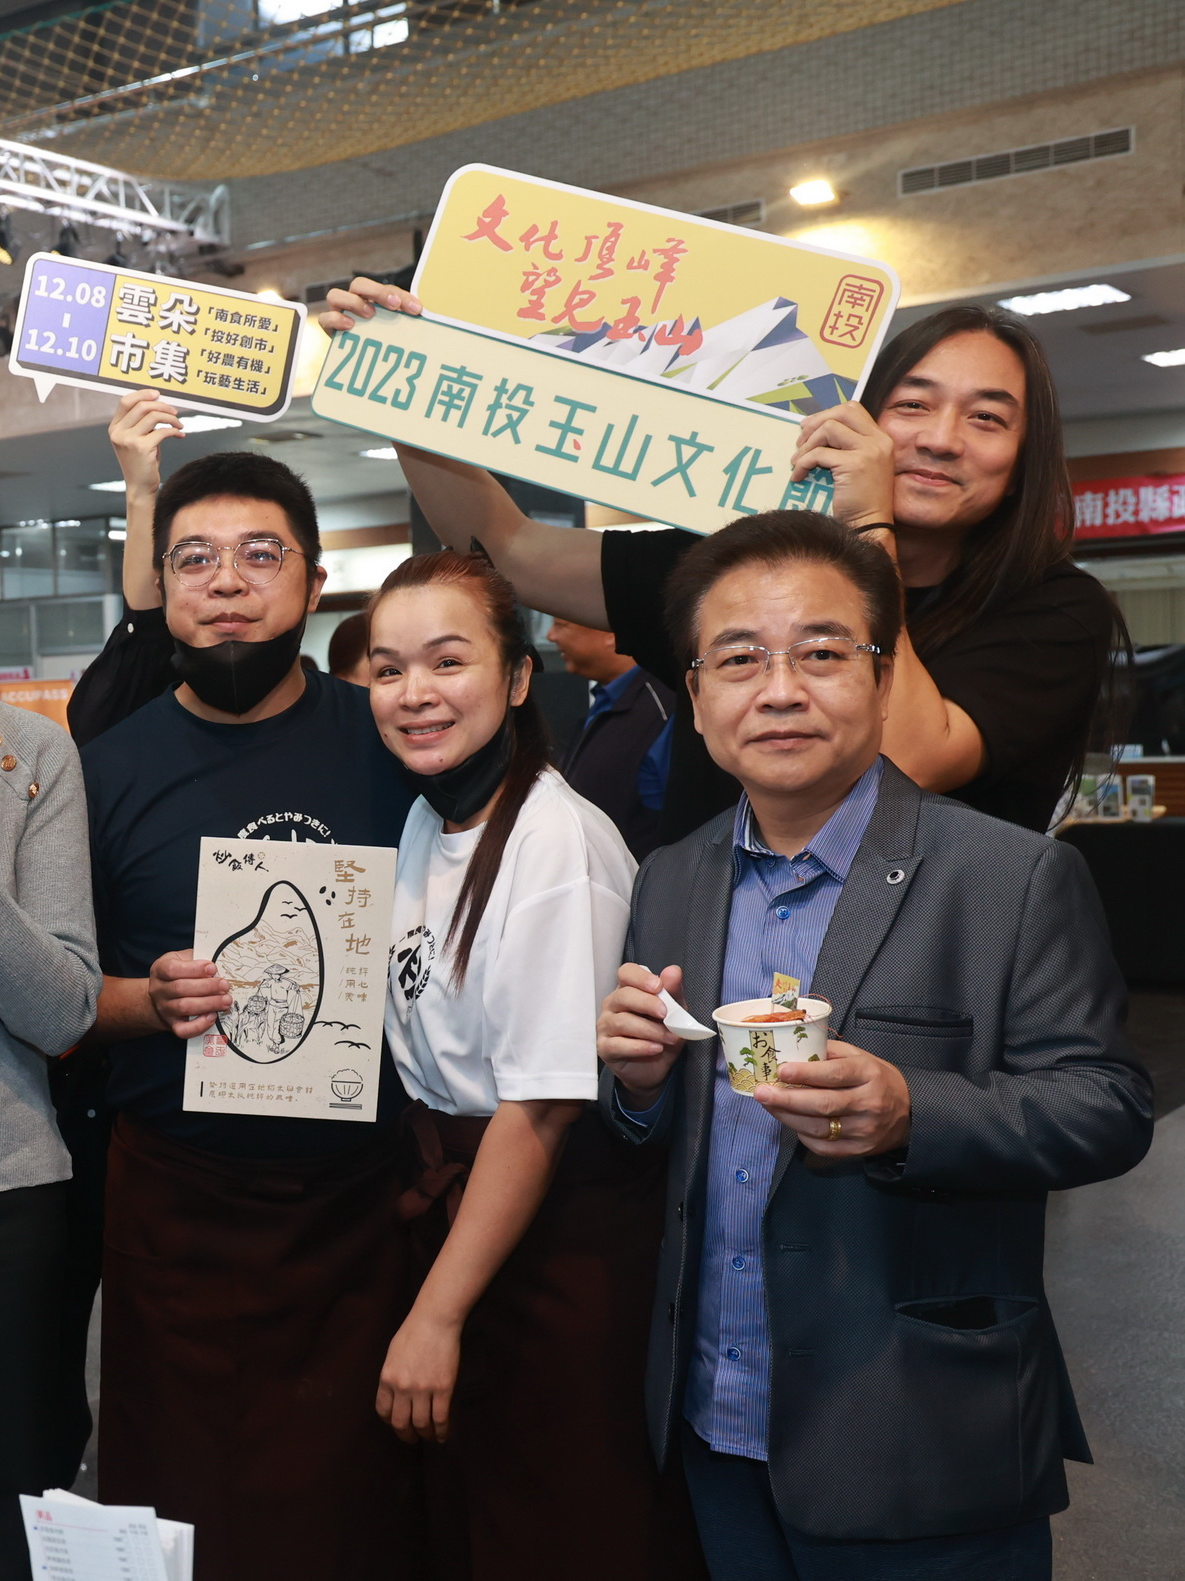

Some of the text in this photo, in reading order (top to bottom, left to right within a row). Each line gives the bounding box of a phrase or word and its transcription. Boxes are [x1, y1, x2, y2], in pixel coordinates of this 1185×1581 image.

[460, 194, 690, 315] 文化頂峰
[34, 275, 107, 308] 12.08
[115, 282, 200, 335] 雲朵
[829, 283, 876, 341] 南投
[208, 306, 279, 333] 「南食所愛」
[24, 329, 98, 362] 12.10
[109, 332, 190, 384] 市集
[204, 327, 275, 354] 「投好創市」
[200, 348, 271, 375] 「好農有機」
[195, 369, 267, 396] 「玩藝生活」
[334, 860, 372, 955] 堅持在地
[752, 1031, 781, 1081] お食事
